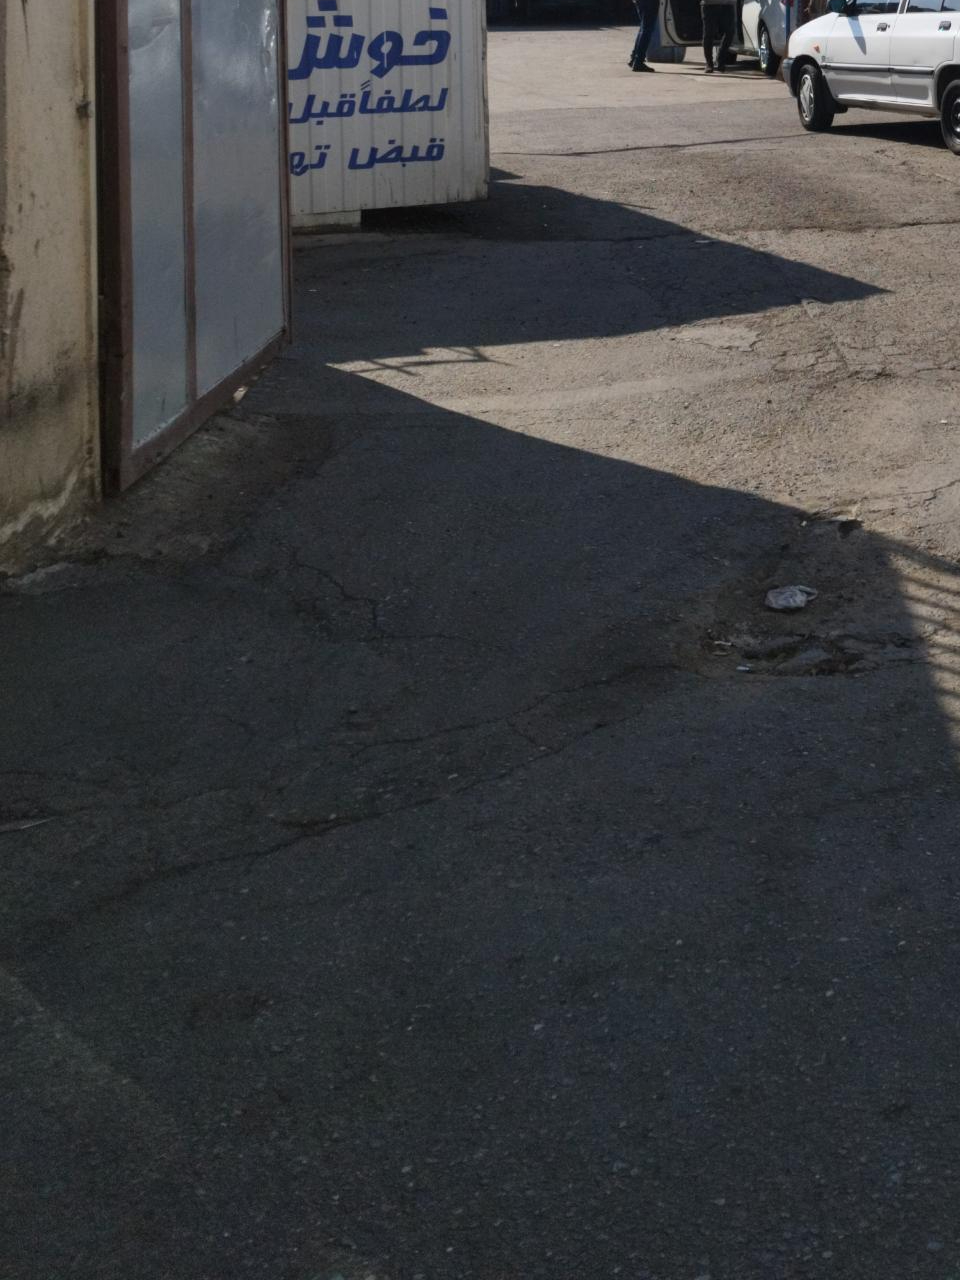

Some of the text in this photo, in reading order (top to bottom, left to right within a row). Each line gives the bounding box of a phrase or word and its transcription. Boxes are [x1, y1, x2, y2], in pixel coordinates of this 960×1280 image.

[287, 0, 451, 81] خوش
[288, 93, 356, 126] قبل
[347, 138, 446, 170] قبض
